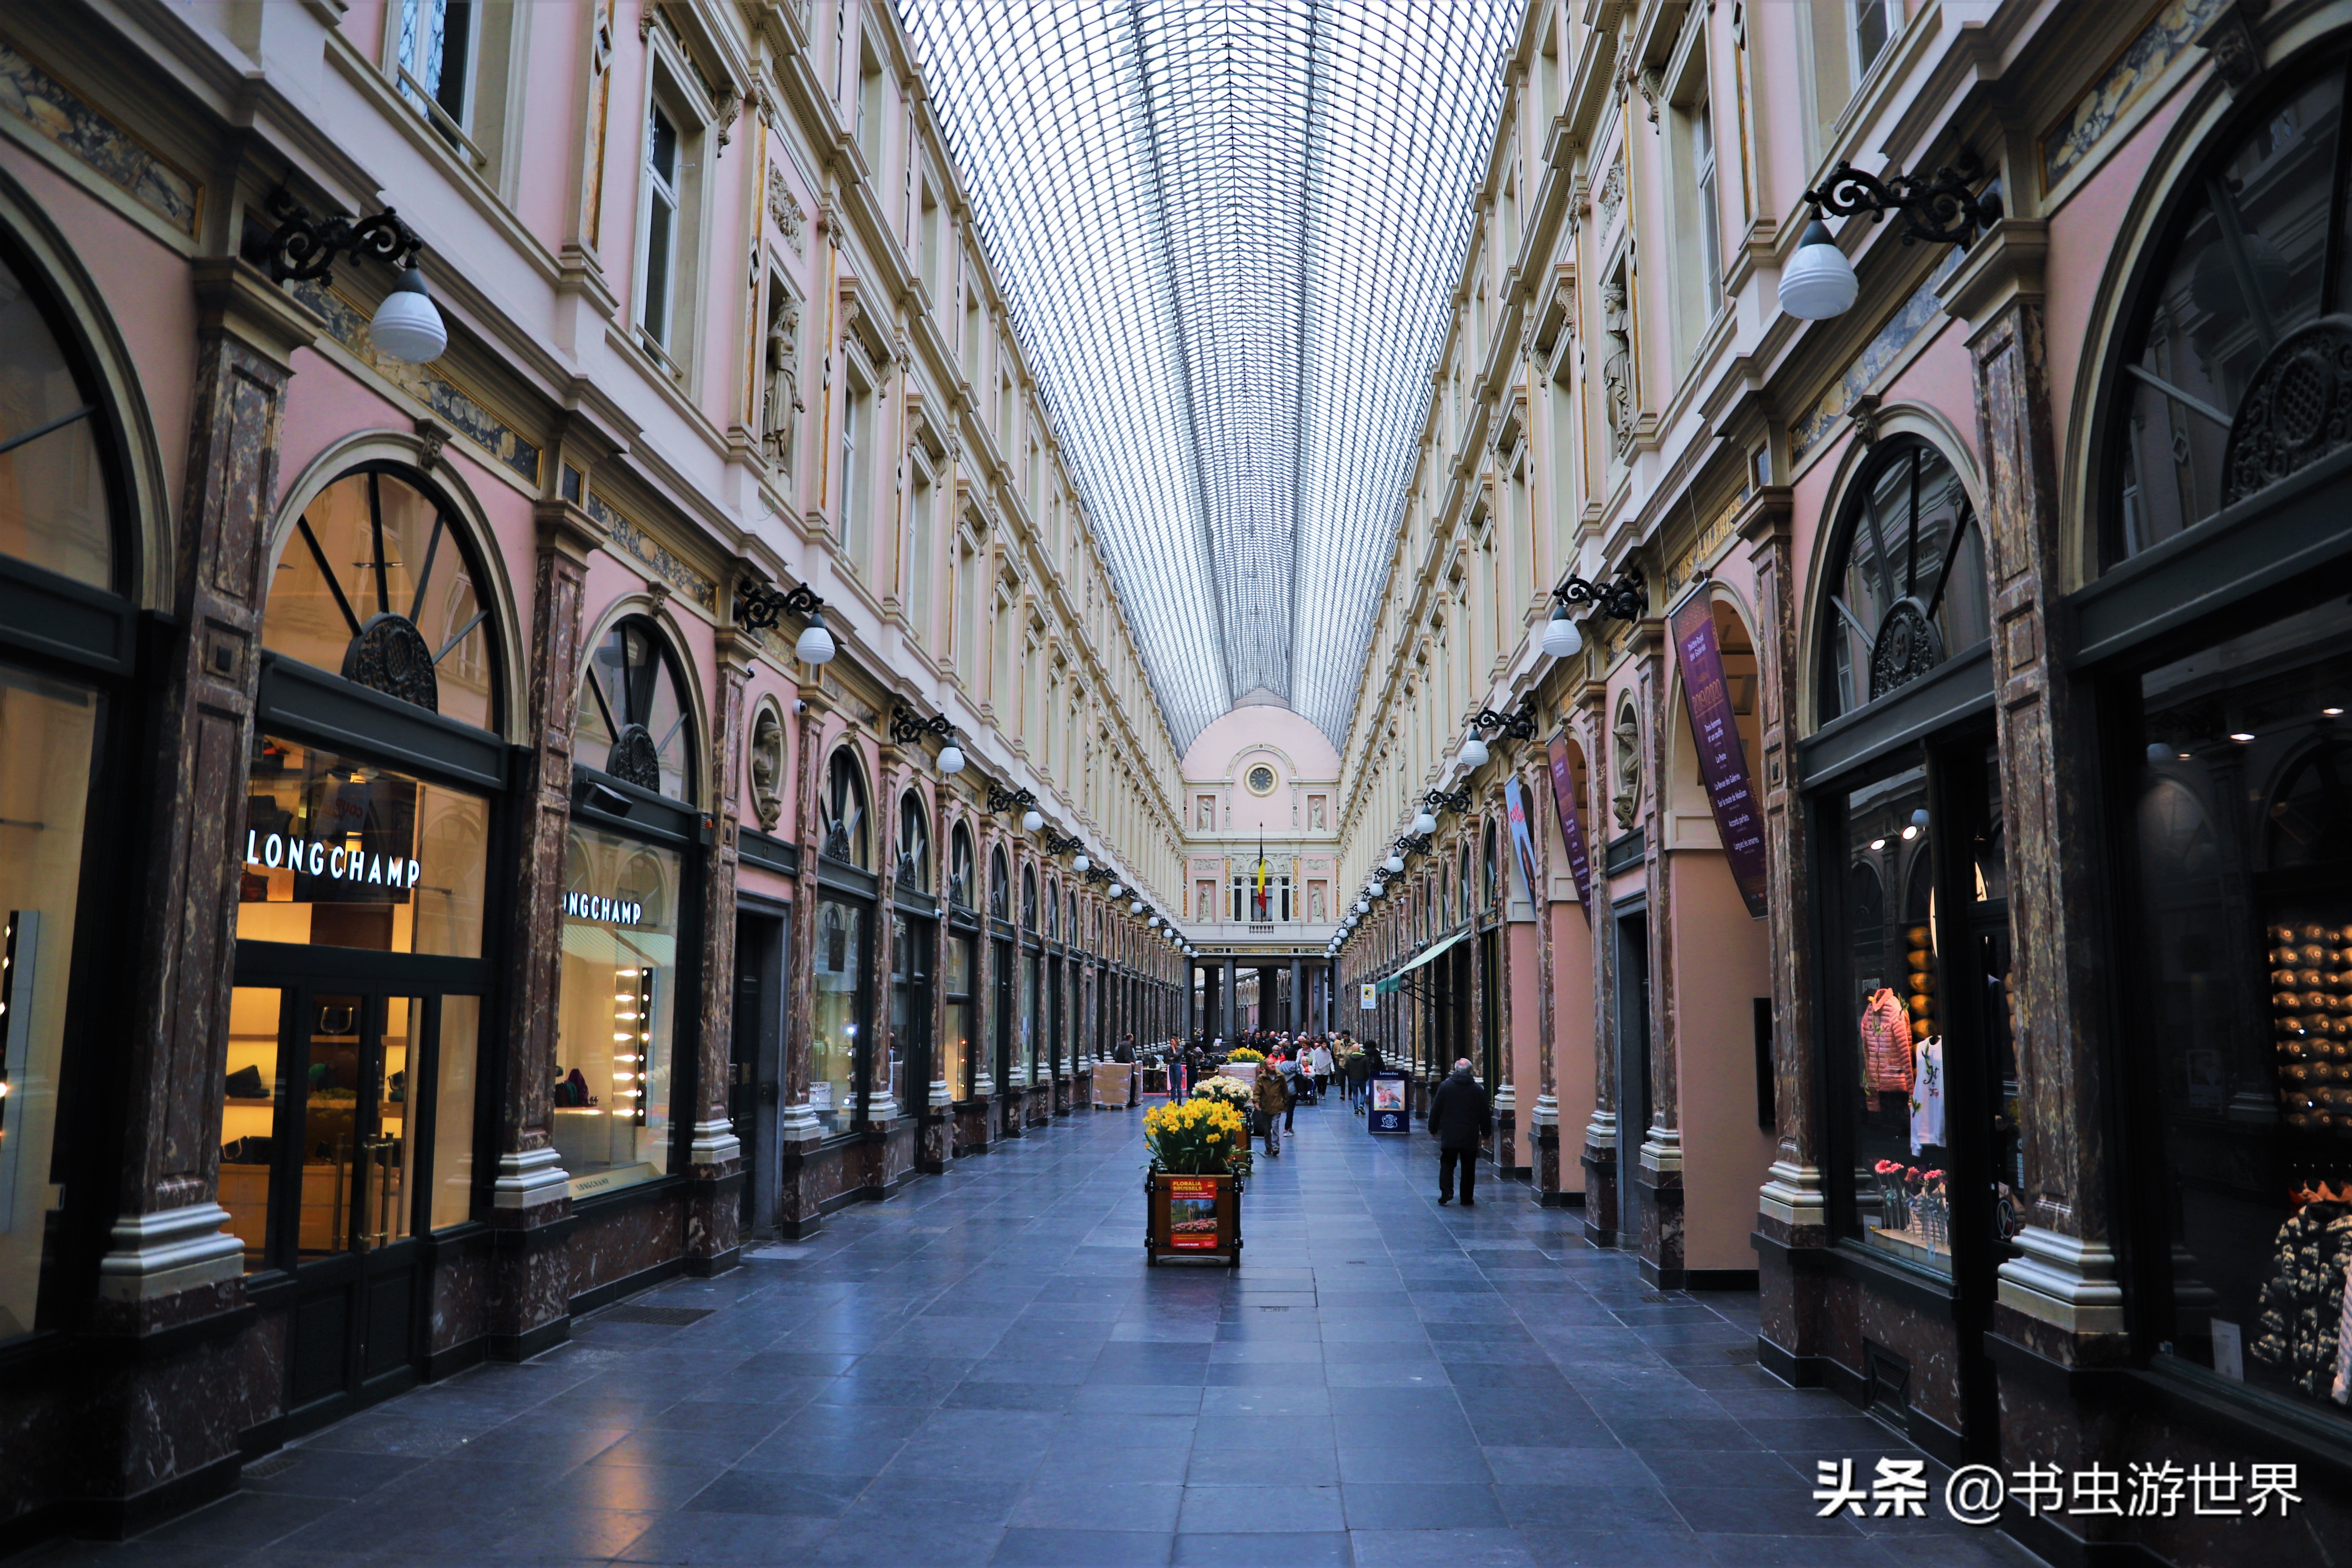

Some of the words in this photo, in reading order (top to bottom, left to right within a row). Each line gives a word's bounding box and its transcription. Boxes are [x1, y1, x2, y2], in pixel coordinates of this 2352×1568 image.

[1692, 678, 1722, 714] 2019/2020
[247, 829, 420, 888] LONGCHAMP
[564, 891, 642, 925] NGCHAMP
[576, 1178, 609, 1191] LONGCHAMP
